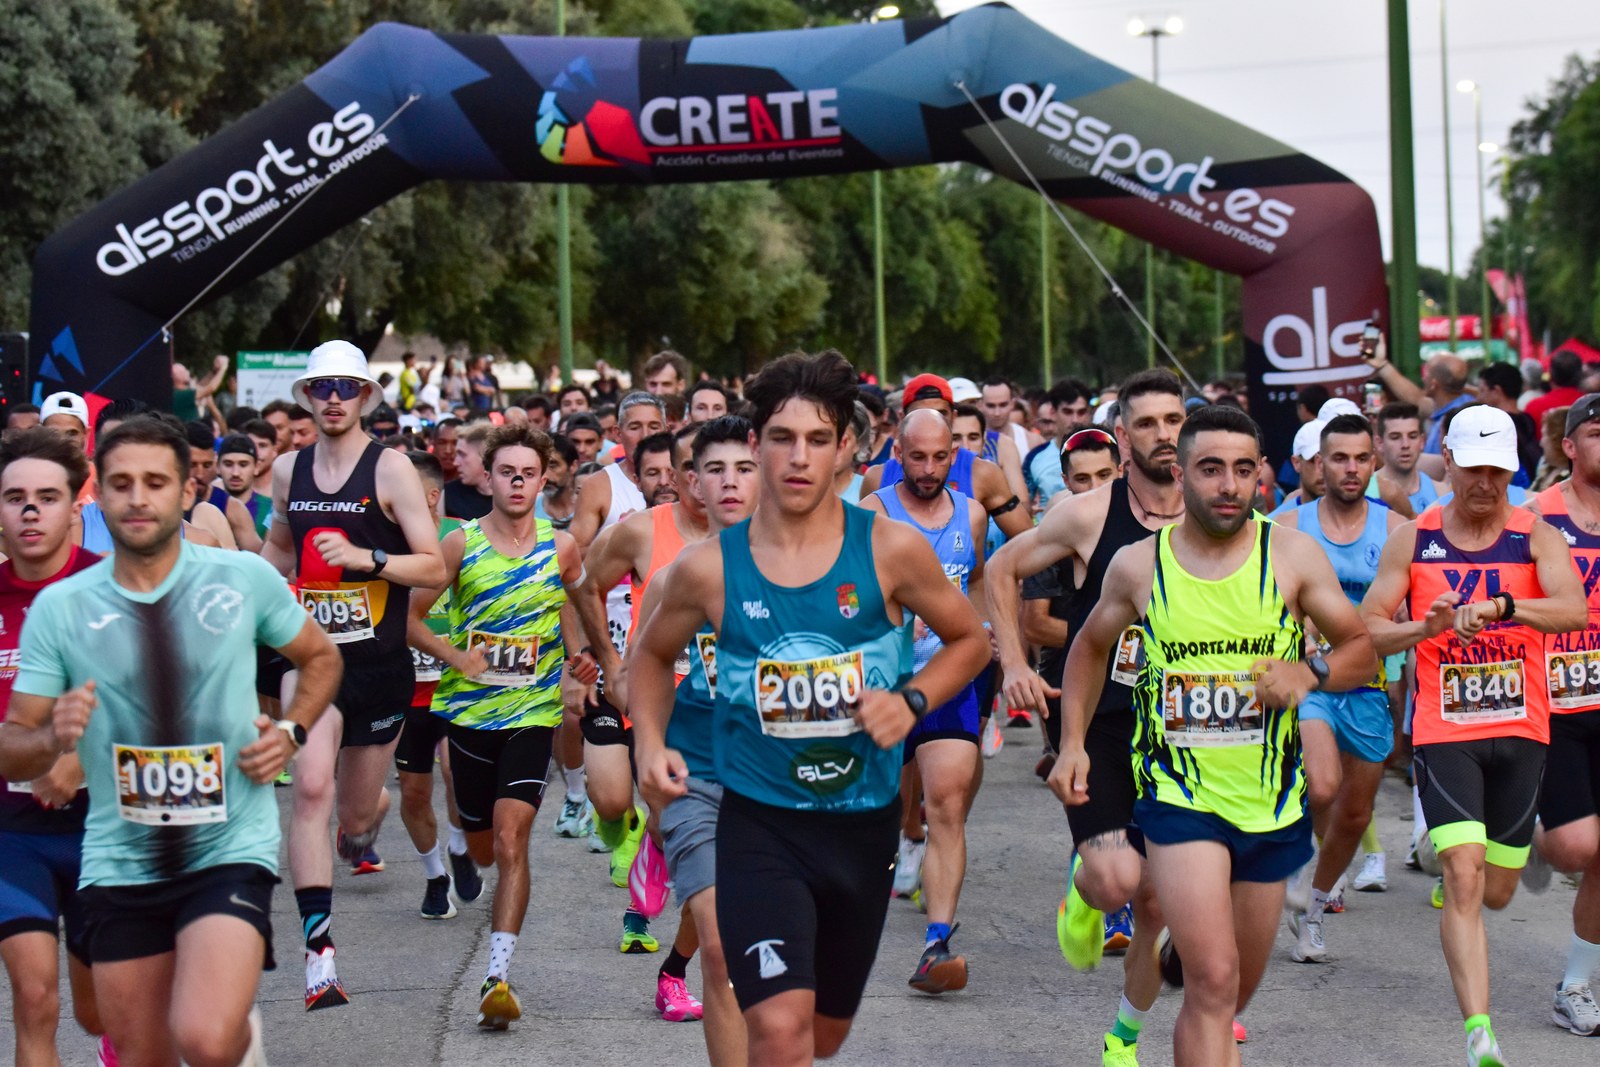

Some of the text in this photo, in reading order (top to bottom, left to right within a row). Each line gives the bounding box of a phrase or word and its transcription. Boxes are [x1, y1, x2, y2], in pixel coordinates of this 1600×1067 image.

[640, 88, 841, 147] CREATE
[656, 147, 843, 167] Acción Creativa de Eventos
[1000, 83, 1295, 238] alssport.es
[96, 100, 375, 277] alssport.es
[170, 133, 388, 263] TIENDA RUNNING TRAIL OUTDOOR
[1047, 143, 1277, 254] TIENDA RUNNING TRAIL OUTDOOR
[288, 500, 366, 513] JOGGING
[305, 597, 367, 625] 2095
[743, 600, 762, 612] RUN
[761, 667, 861, 710] 2060
[1192, 674, 1220, 683] NOCTURNA
[1222, 674, 1231, 682] DEL
[1447, 671, 1521, 702] 1840
[1169, 685, 1260, 719] 1802
[121, 759, 220, 797] 1098
